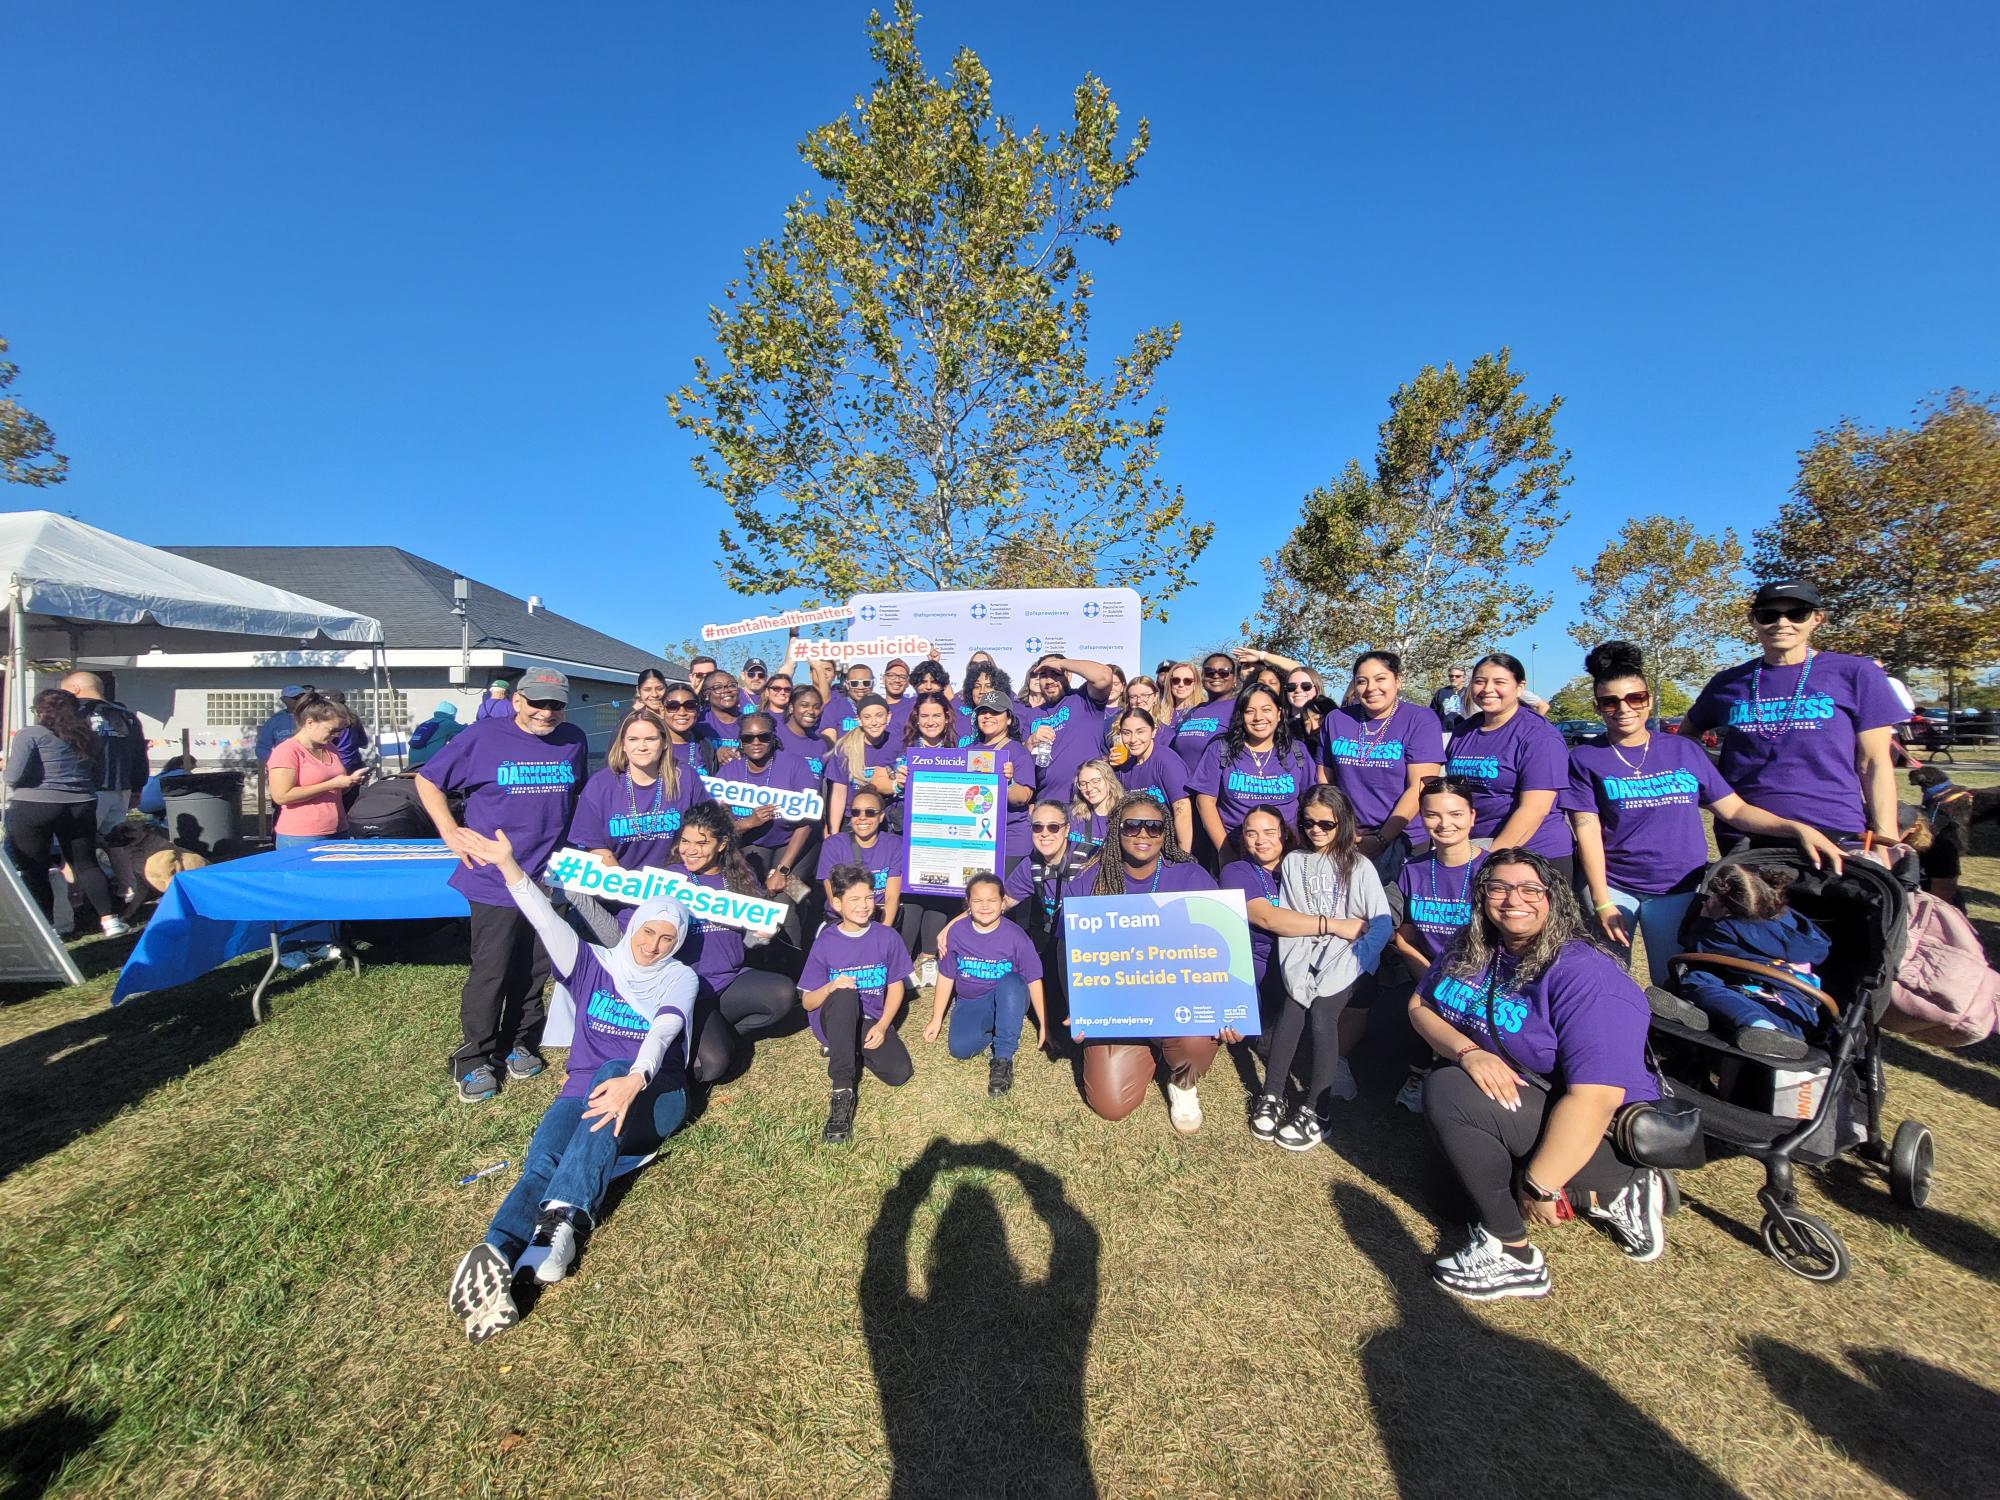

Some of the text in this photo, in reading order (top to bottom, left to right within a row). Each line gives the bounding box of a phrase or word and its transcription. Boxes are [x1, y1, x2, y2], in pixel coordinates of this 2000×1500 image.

[704, 606, 853, 639] #mentalhealthmatters
[793, 638, 928, 661] #stopsuicide
[912, 755, 967, 769] Zero Suicide
[497, 765, 576, 786] DARKNESS
[1603, 773, 1699, 800] DARKNESS
[704, 781, 820, 816] eenough
[557, 856, 781, 926] #bealifesaver
[1066, 911, 1160, 934] Top Team
[1071, 944, 1217, 967] Bergen's Promise
[1072, 968, 1230, 989] Zero Suicide Team
[1075, 1016, 1154, 1027] afsp.org/newjersey
